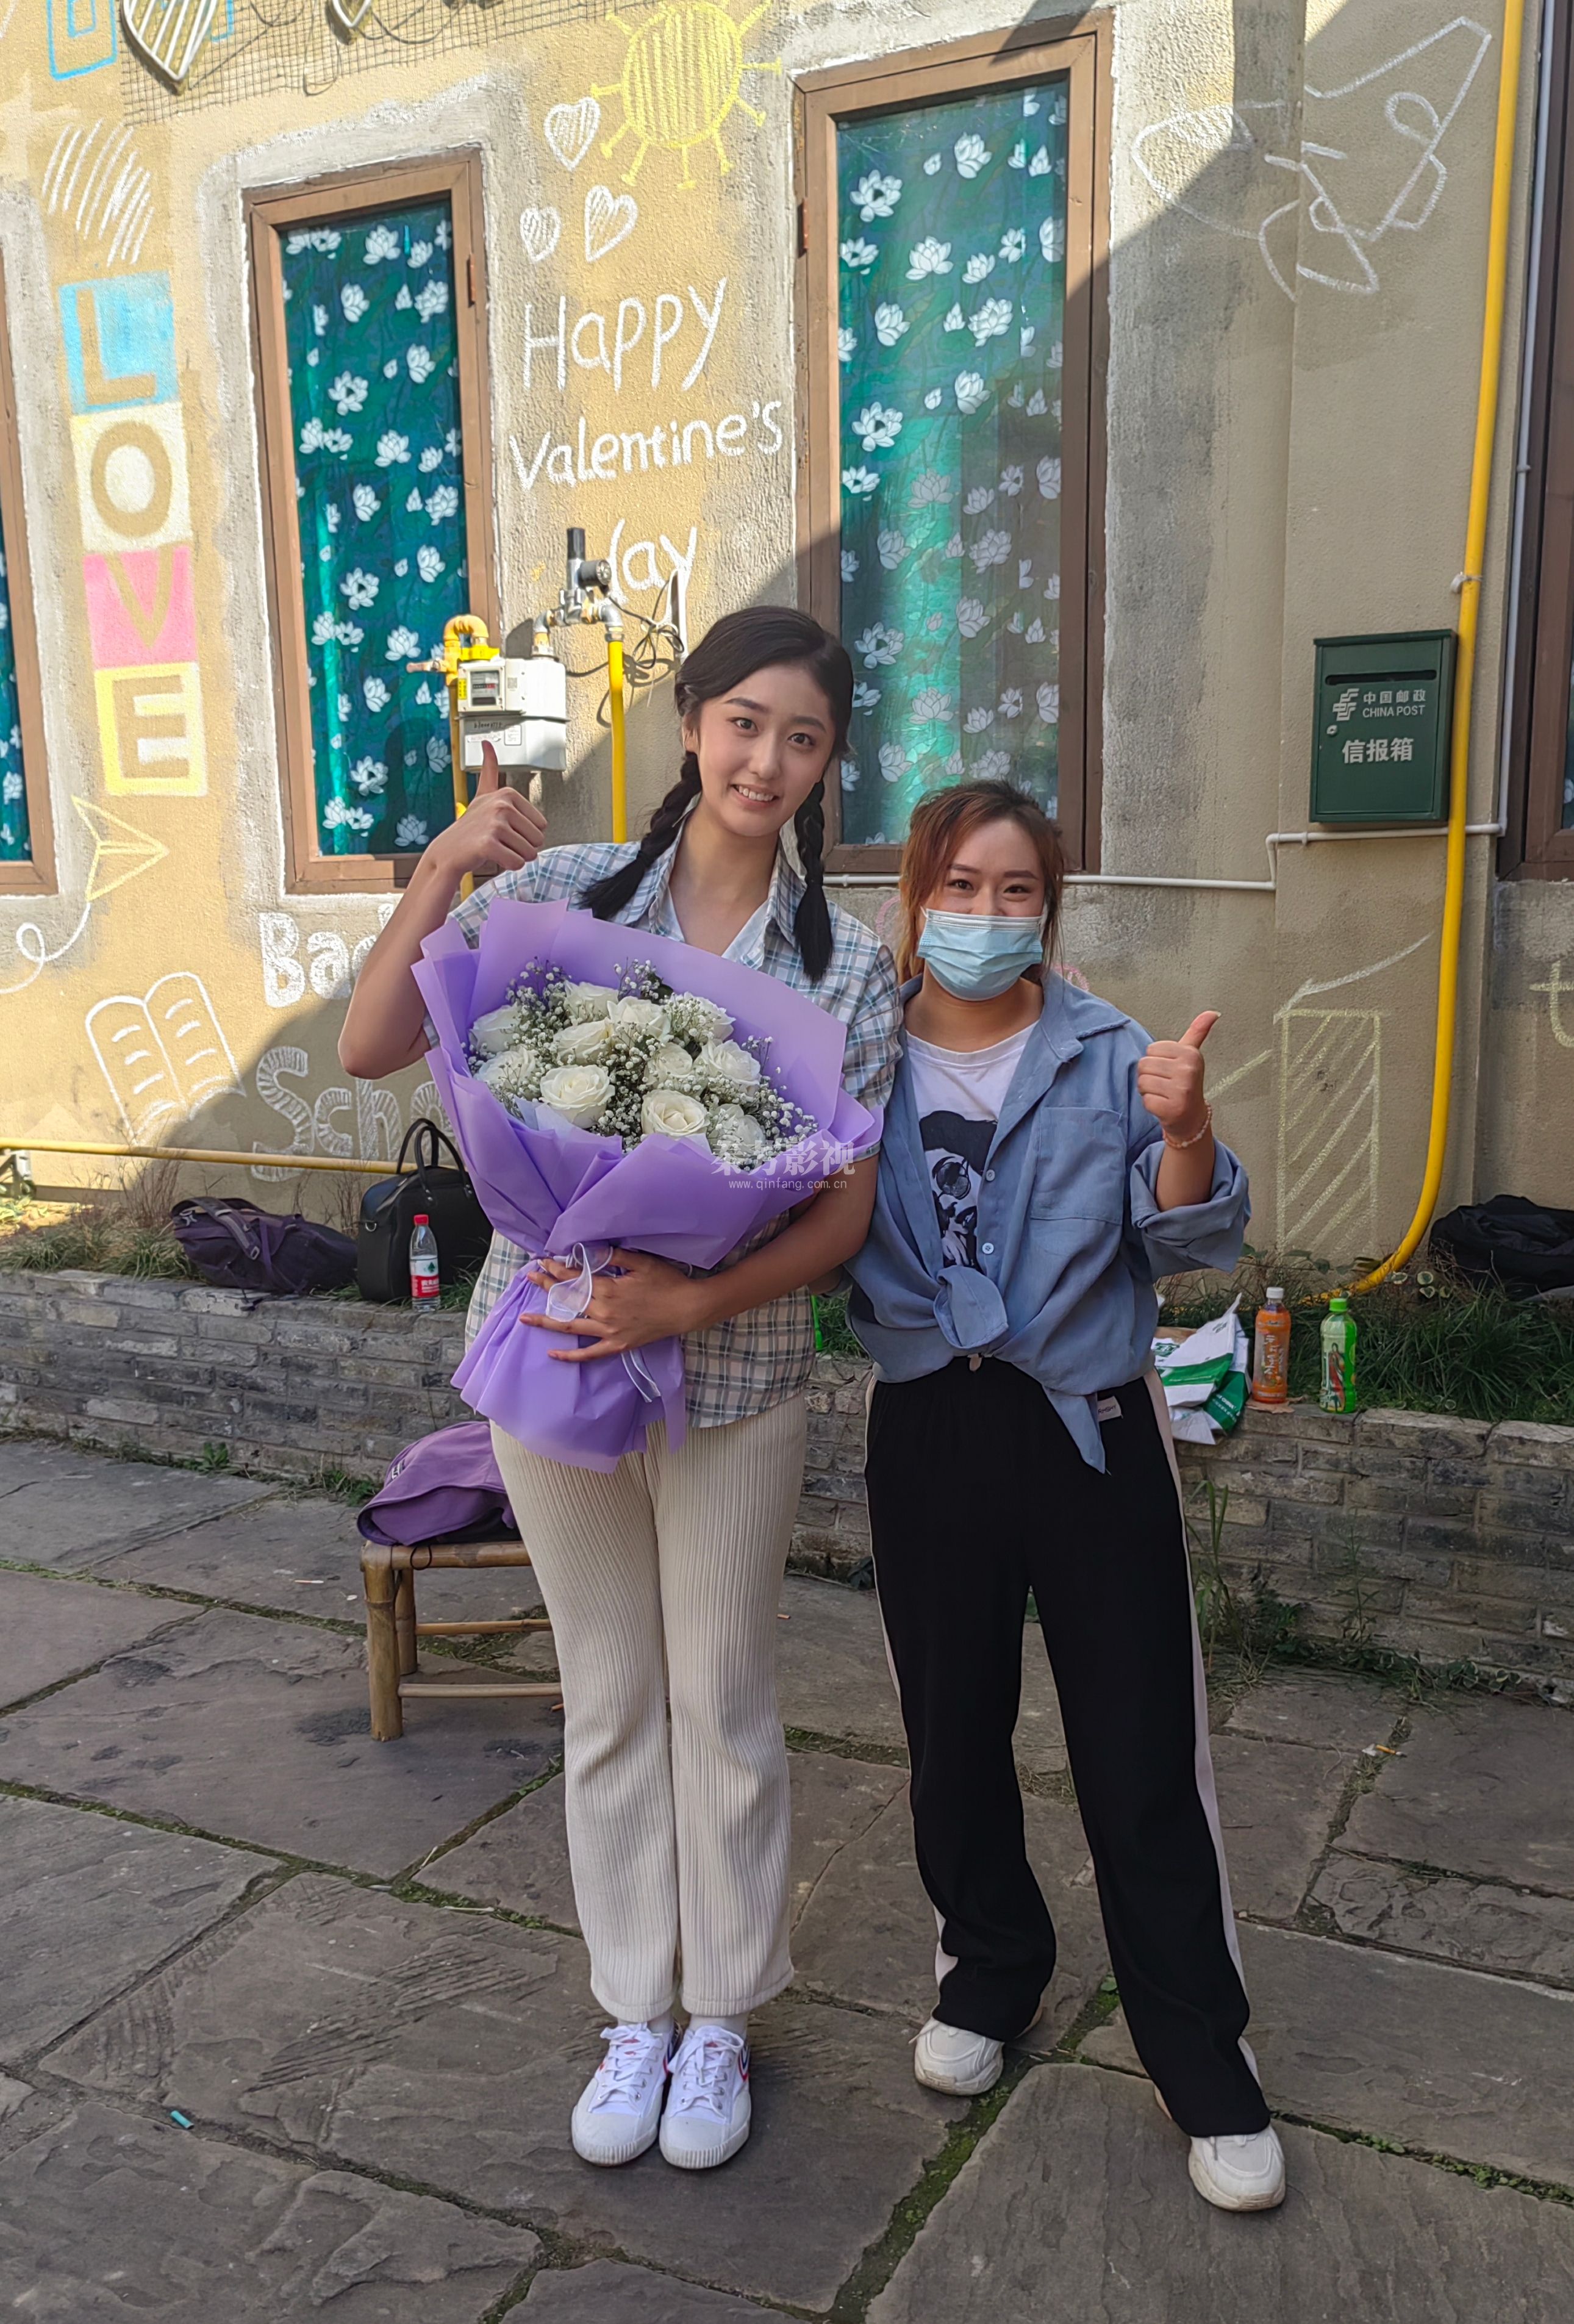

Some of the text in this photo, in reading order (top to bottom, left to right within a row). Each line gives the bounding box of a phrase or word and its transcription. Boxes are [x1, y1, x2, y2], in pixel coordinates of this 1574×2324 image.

[509, 400, 782, 492] Valentine's
[76, 287, 191, 780] LOVE
[1363, 689, 1426, 705] 中国邮政
[1362, 705, 1426, 718] CHINA POST
[1342, 737, 1414, 764] 信报箱
